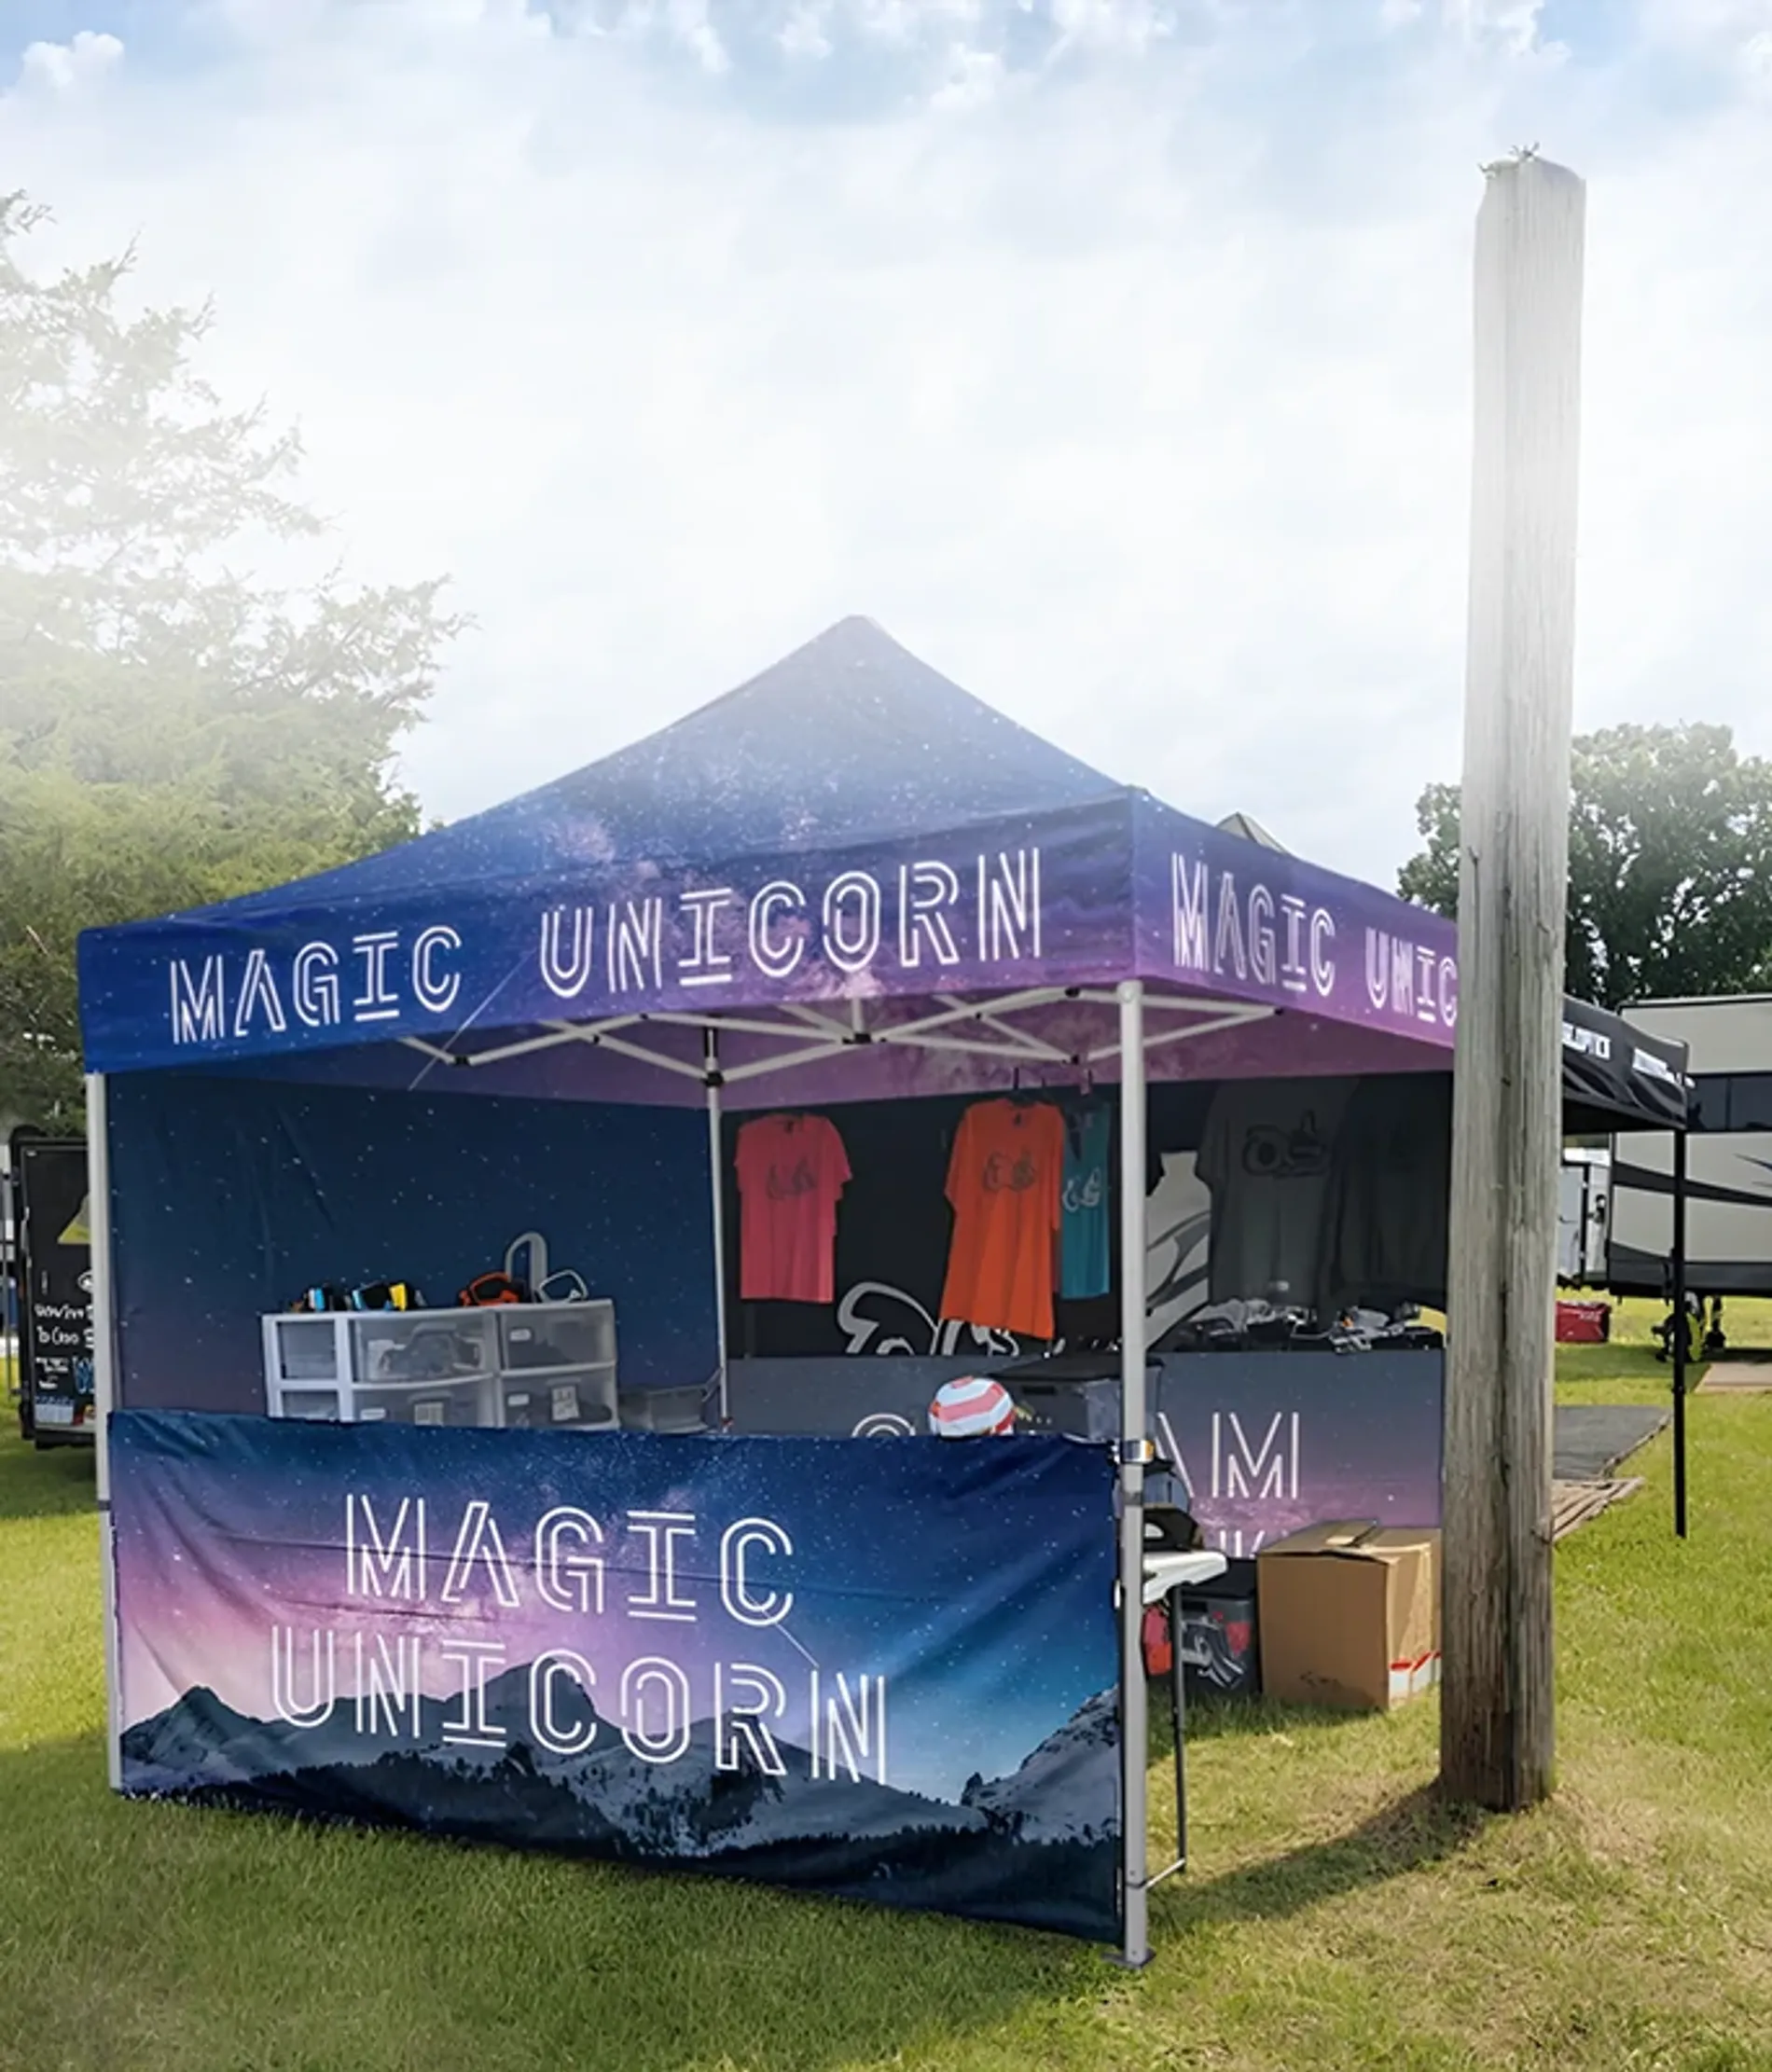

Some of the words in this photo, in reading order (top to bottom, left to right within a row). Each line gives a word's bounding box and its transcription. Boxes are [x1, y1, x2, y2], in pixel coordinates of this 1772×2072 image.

[170, 925, 462, 1044] MAGIC
[540, 848, 1041, 999] UNICORN
[1171, 851, 1336, 998] MAGIC
[346, 1492, 795, 1628] MAGIC
[270, 1624, 886, 1786] UNICORN
